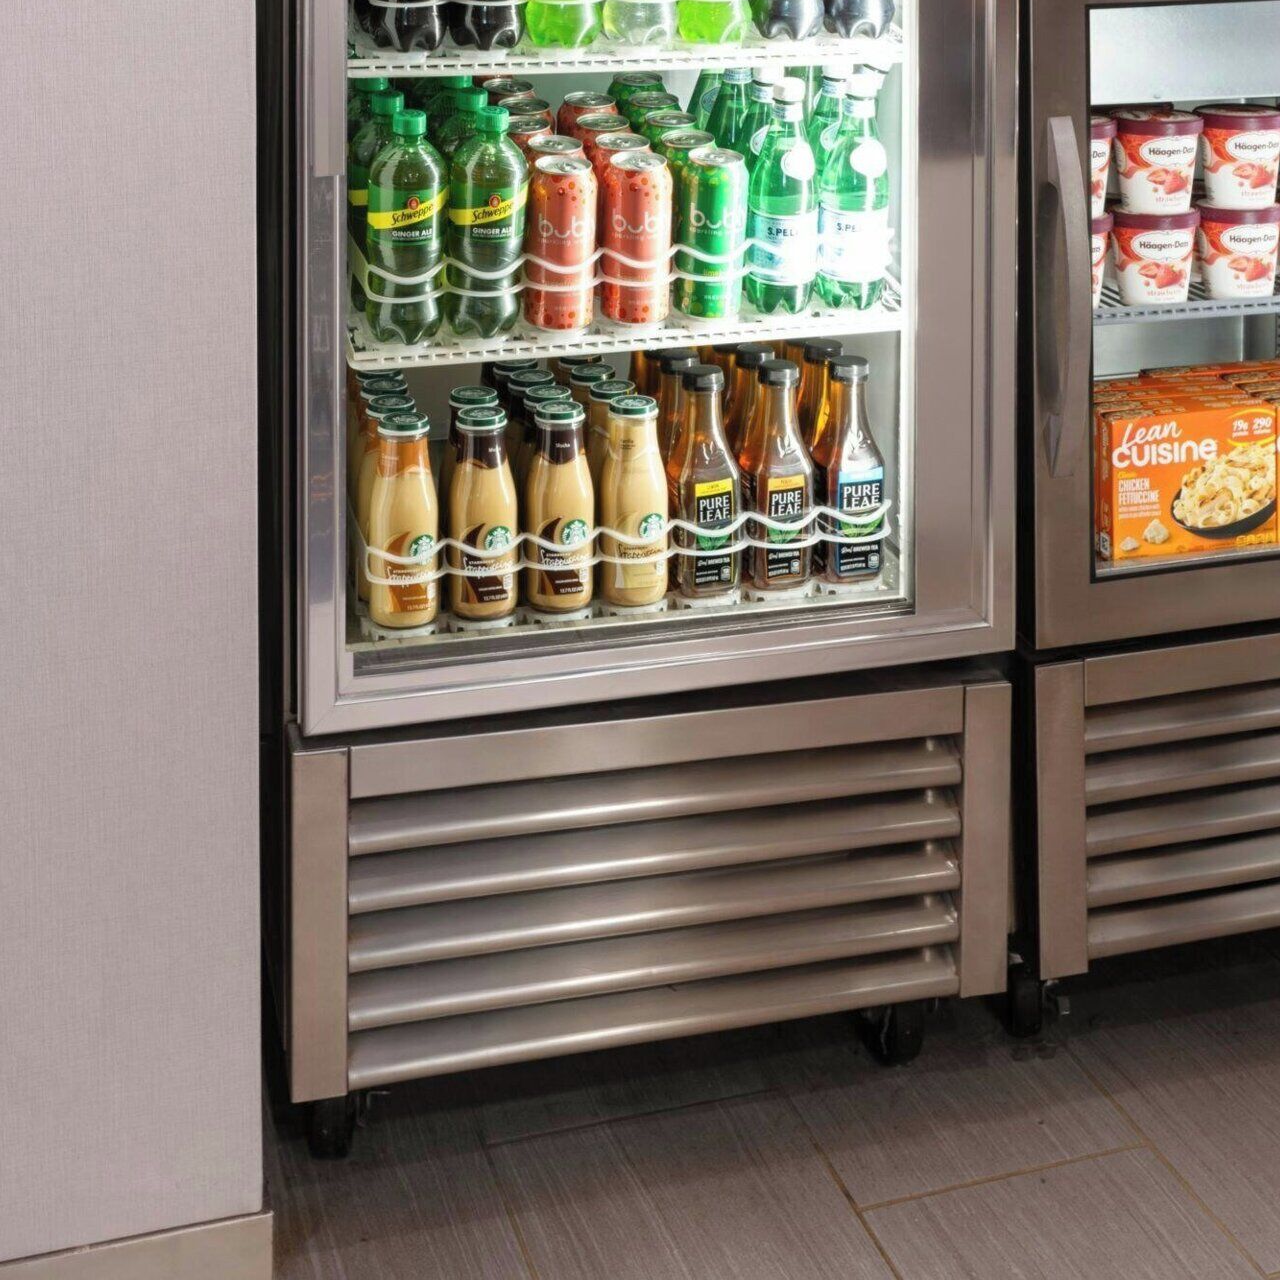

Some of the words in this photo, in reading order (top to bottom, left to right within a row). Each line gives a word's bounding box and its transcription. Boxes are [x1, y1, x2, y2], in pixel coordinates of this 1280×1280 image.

[1148, 146, 1194, 157] Häagen-Daz
[1234, 140, 1280, 151] Häagen-Daz
[391, 203, 433, 225] Schweppe
[472, 202, 512, 222] Schweppe
[392, 229, 419, 237] GINGER
[421, 228, 433, 236] ALE
[472, 227, 501, 235] GINGER
[1229, 233, 1276, 245] Häagen-Daz
[1253, 416, 1272, 431] 290
[1122, 421, 1183, 452] Lean
[771, 490, 801, 506] PURE
[843, 483, 880, 498] PURE
[699, 494, 730, 511] PURE
[700, 508, 730, 524] LEAF
[771, 504, 802, 518] LEAF
